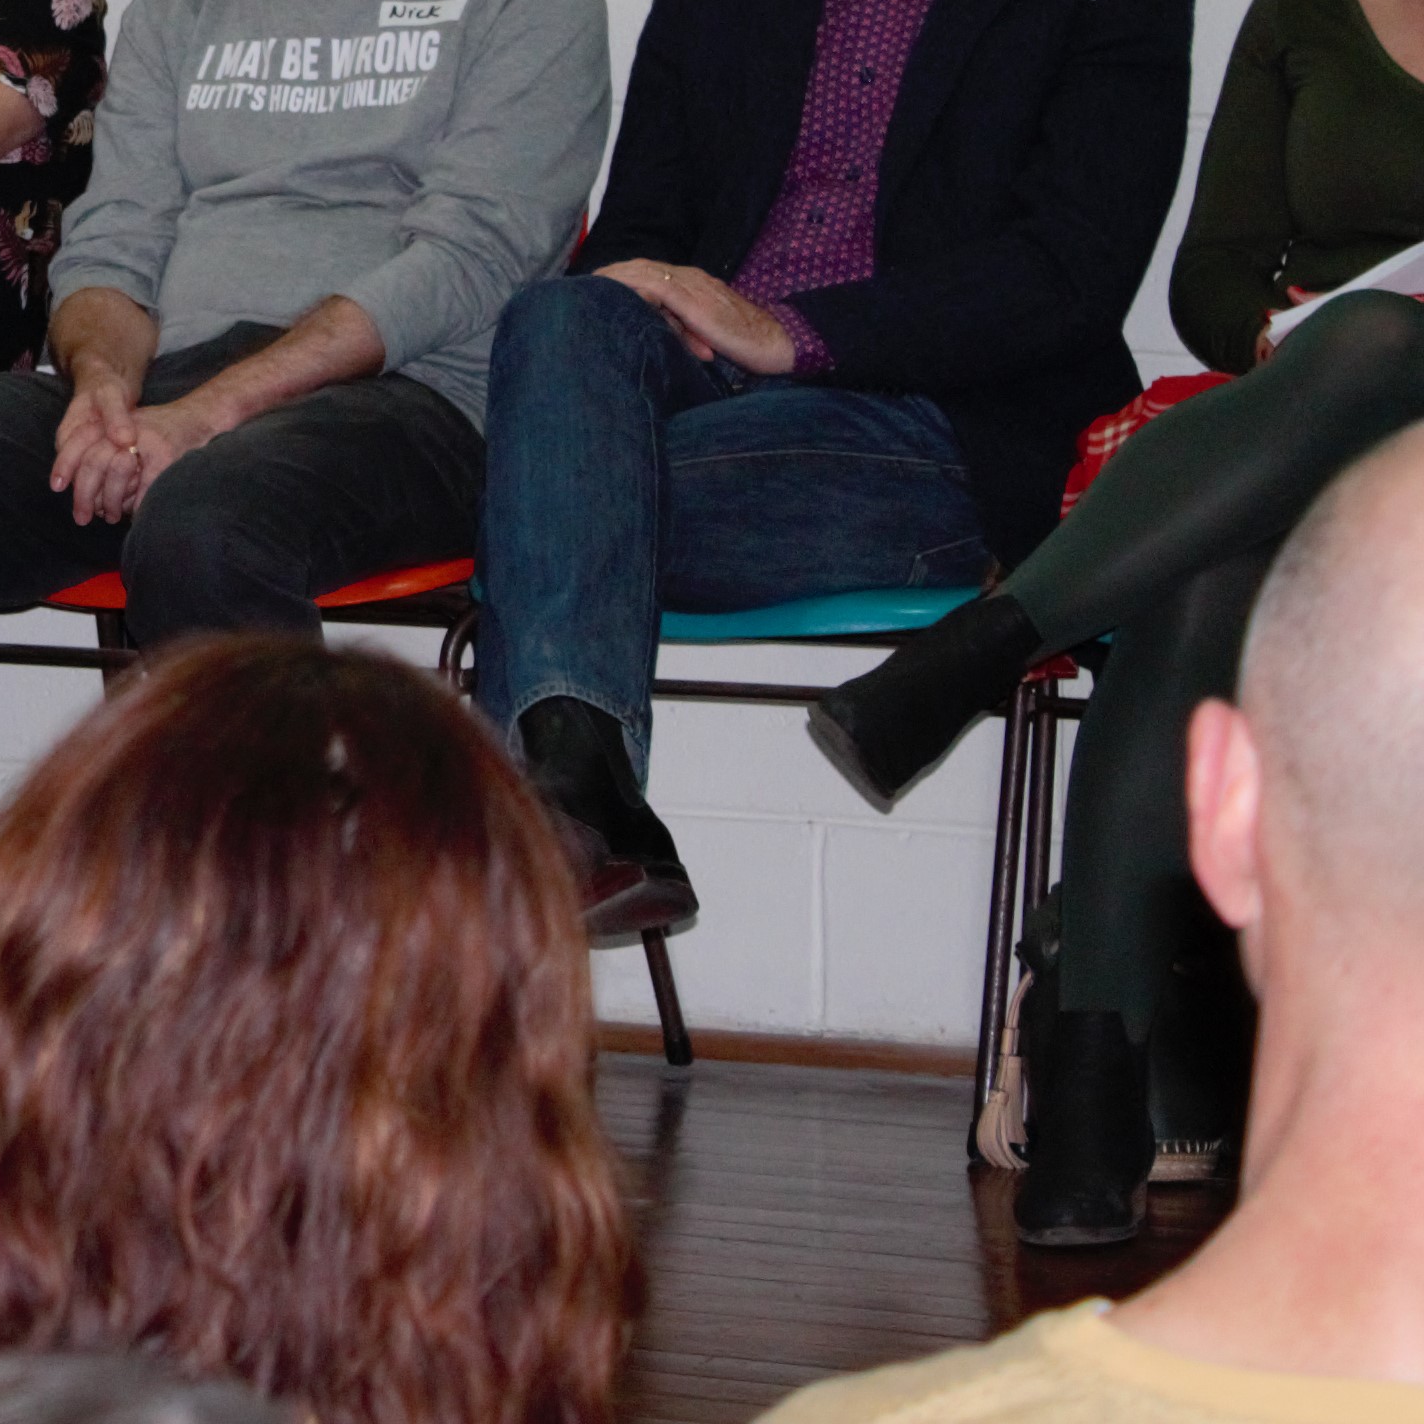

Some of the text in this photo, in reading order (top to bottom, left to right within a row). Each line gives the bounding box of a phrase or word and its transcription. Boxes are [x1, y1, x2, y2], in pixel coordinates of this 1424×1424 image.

[197, 30, 440, 81] I MAY BE WRONG
[186, 83, 225, 111] BUT
[225, 83, 266, 112] IT'S
[268, 83, 341, 113] HIGHLY
